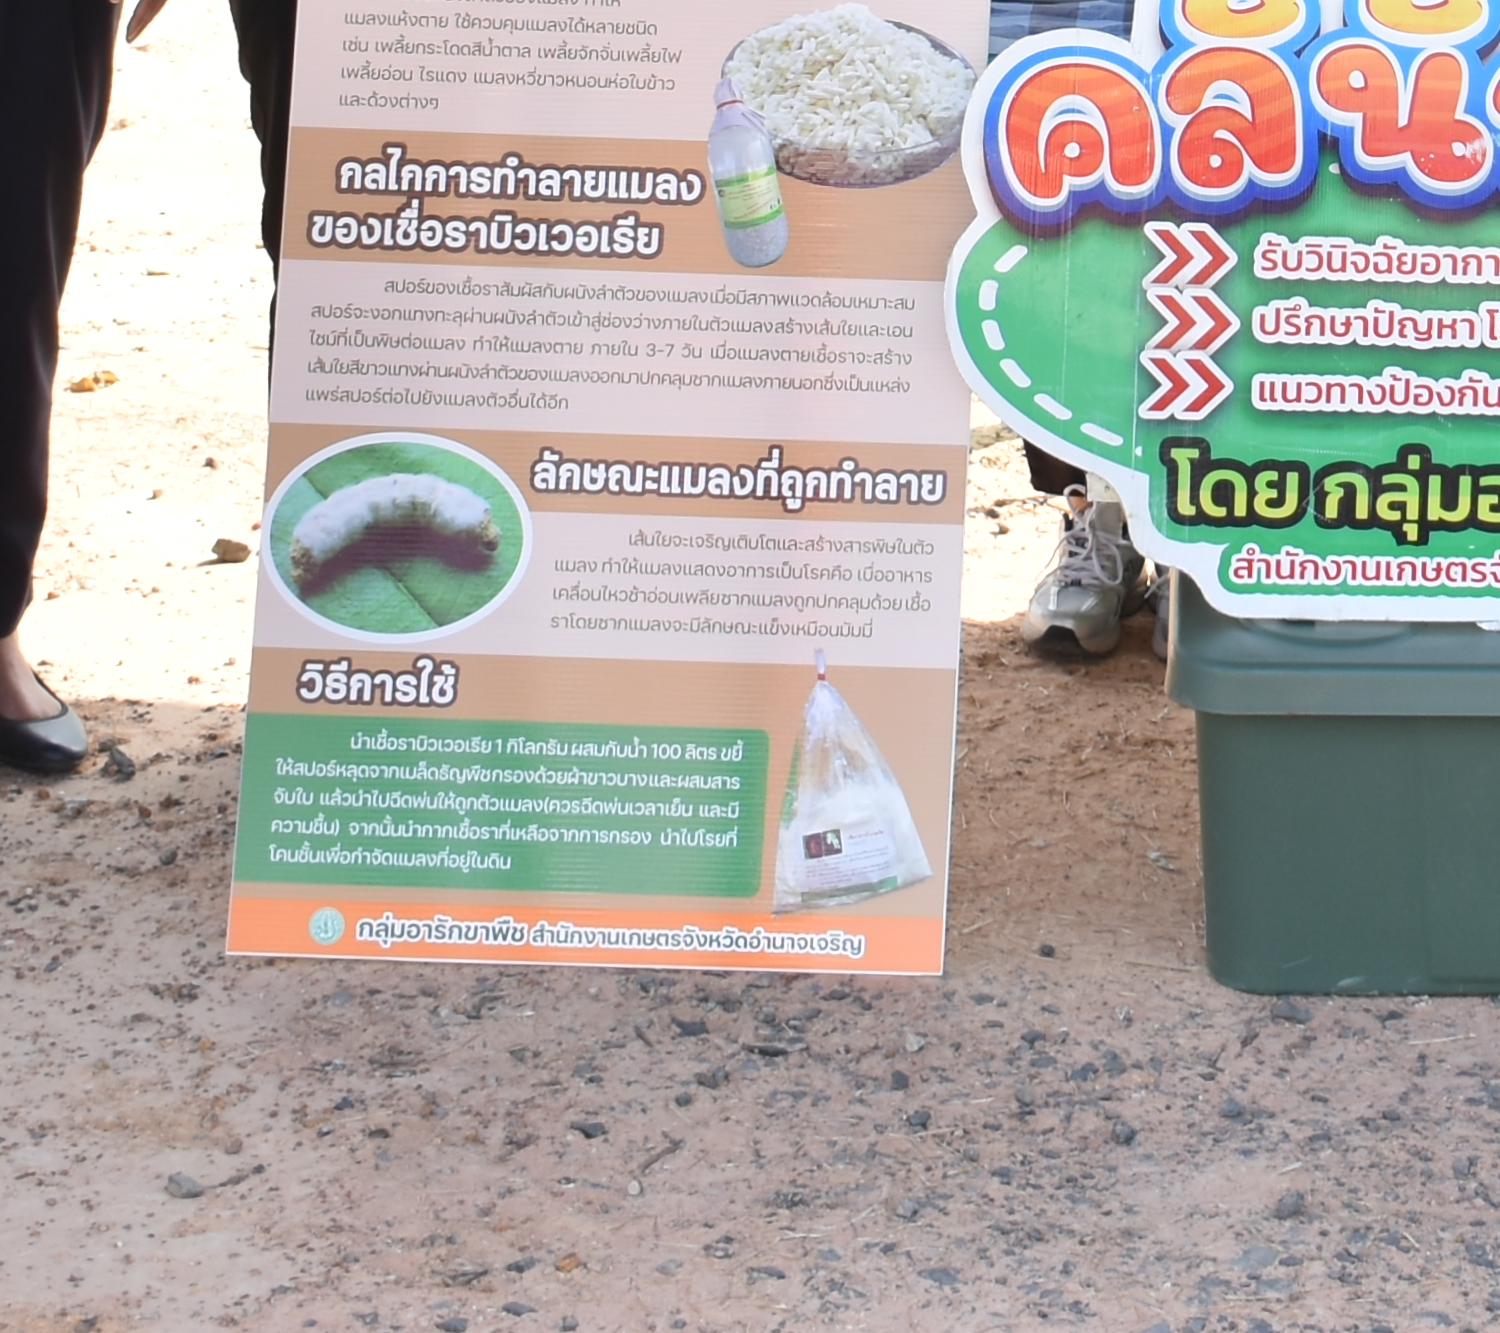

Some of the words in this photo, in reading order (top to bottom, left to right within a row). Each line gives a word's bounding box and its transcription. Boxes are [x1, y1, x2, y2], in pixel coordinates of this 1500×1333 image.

[344, 11, 449, 30] แมลงแห้งตาย
[454, 13, 658, 36] ใช้ควบคุมแมลงได้หลายชนิด
[342, 37, 369, 54] เช่น
[340, 61, 413, 81] เพลี้ยอ่อน
[418, 66, 467, 84] ไรแดง
[338, 91, 439, 111] และด้วงต่างๆ
[339, 147, 701, 201] กลไกการทำลายแมลง
[1258, 304, 1479, 353] ปรึกษาปัญหา
[473, 334, 583, 355] ทำให้แมลงตาย
[590, 340, 638, 358] ภายใน
[681, 343, 702, 359] วัน
[533, 447, 944, 508] ลักษณะแมลงที่ถูกทำลาย
[1170, 447, 1301, 517] โดย
[554, 558, 598, 574] แมลง
[299, 657, 457, 704] วิธีการใช้
[351, 728, 491, 754] นำเชื้อราบิวเวอเรีย
[506, 737, 567, 756] กิโลกรัม
[571, 736, 647, 759] ผสมกับน้ำ
[651, 744, 681, 759] 100
[685, 744, 717, 760] ลิตร
[274, 787, 314, 805] จับใบ
[699, 801, 739, 819] และมี
[661, 827, 738, 848] นำไปโรยที่
[357, 913, 525, 949] กลุ่มอารักขาพืช
[530, 924, 863, 957] สำนักงานเกษตรจังหวัดอำนาจเจริญ
